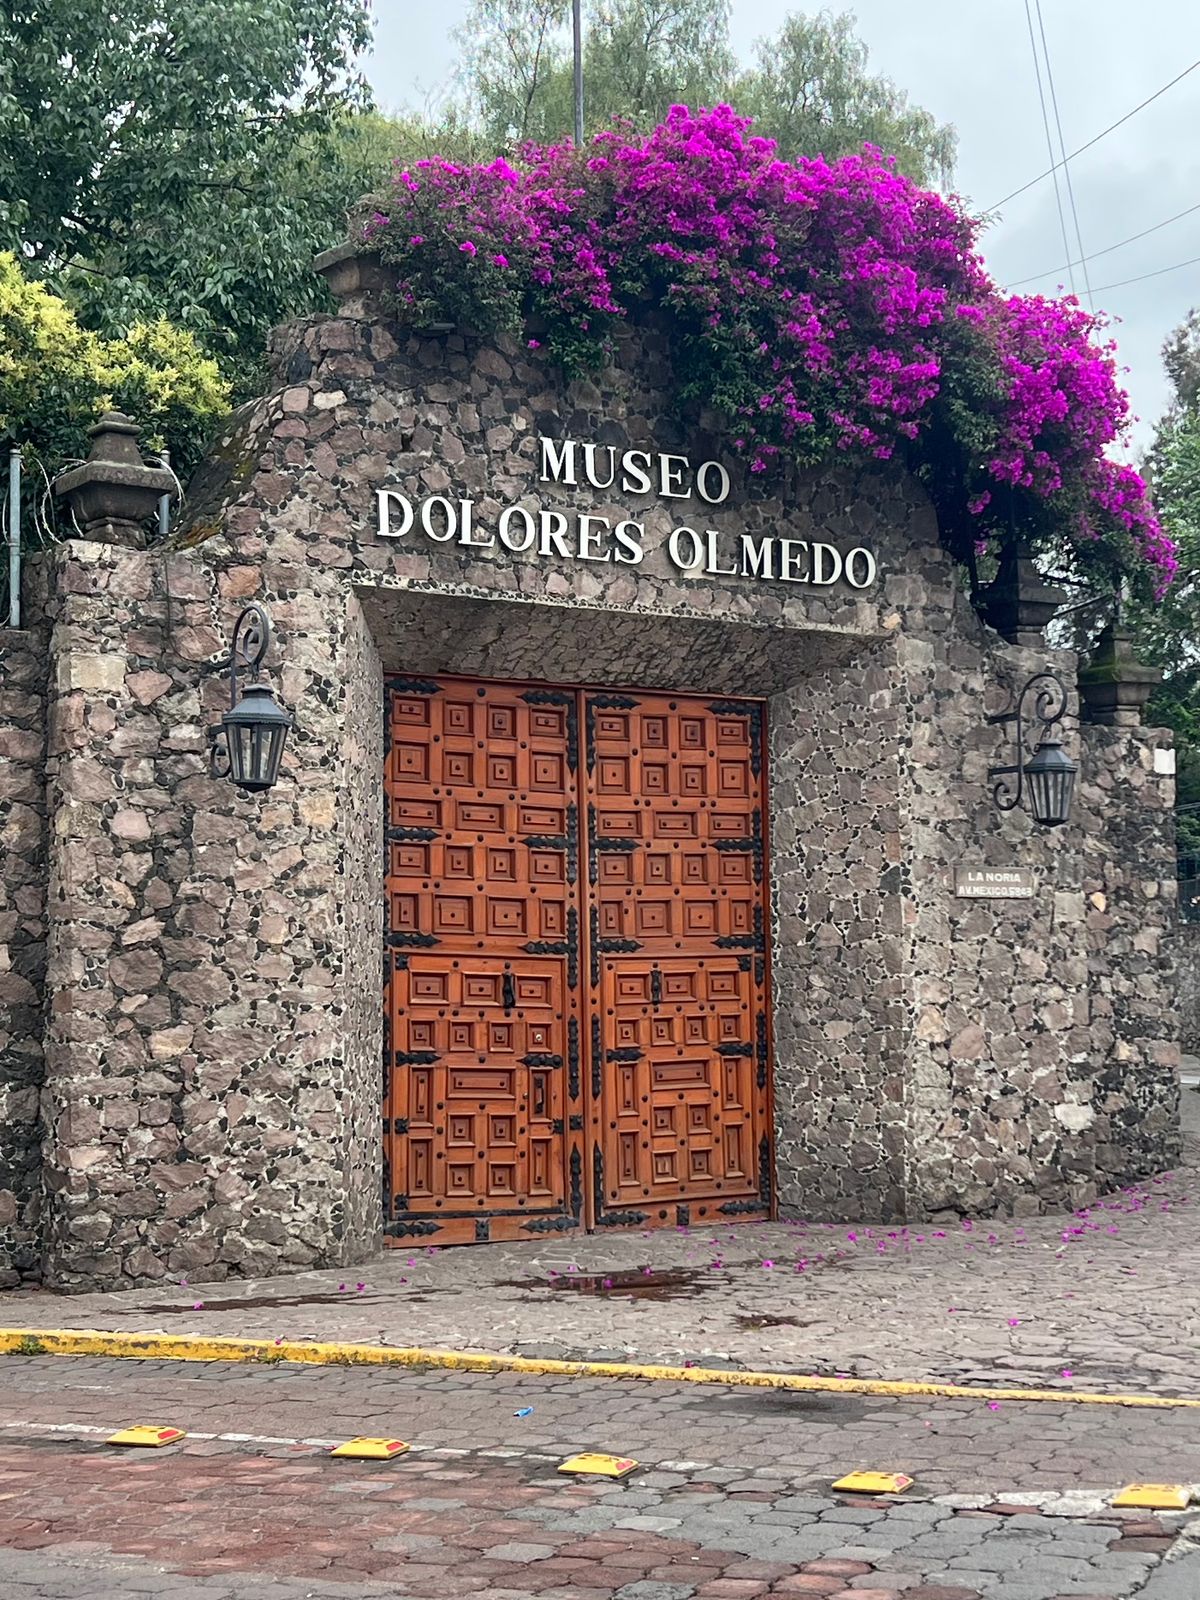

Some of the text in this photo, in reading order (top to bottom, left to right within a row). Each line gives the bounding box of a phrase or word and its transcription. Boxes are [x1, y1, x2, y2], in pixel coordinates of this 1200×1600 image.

[539, 436, 731, 503] MUSEO
[375, 489, 877, 589] DOLORES OLMEDO
[967, 871, 1021, 882] LA NORIA
